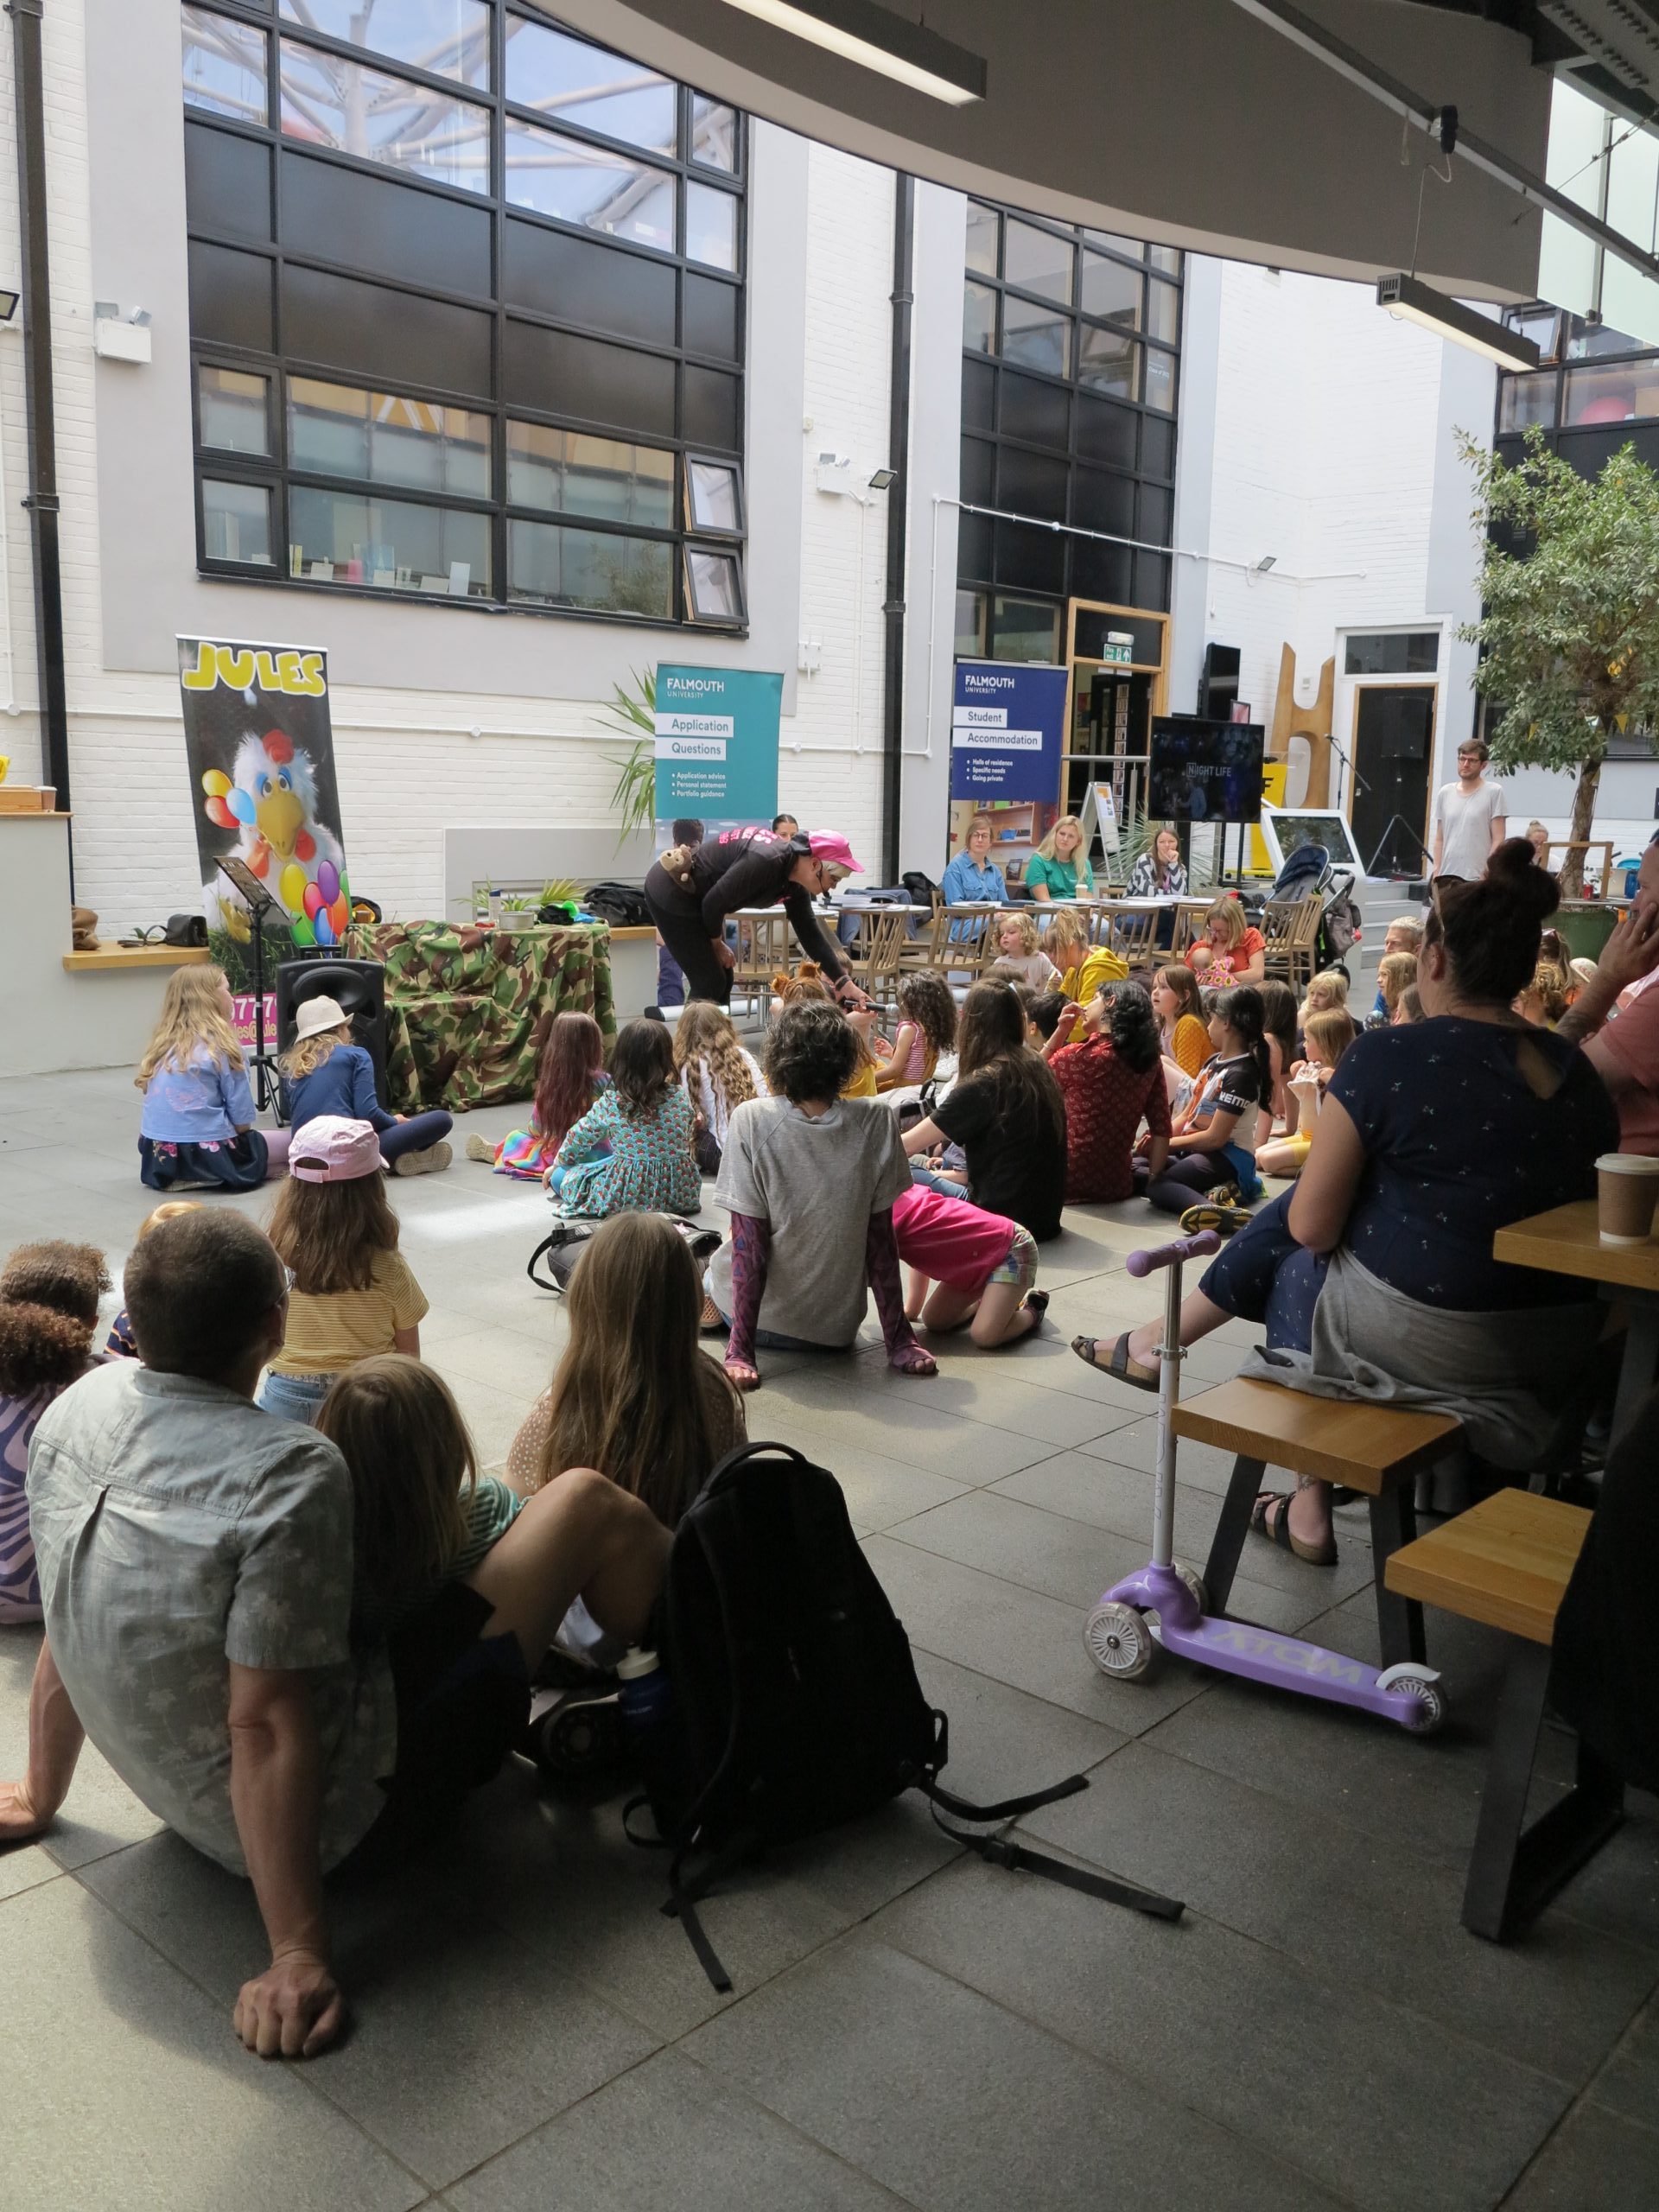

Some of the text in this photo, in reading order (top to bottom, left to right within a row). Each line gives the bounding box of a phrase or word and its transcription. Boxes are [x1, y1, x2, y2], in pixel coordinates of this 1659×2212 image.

[182, 642, 326, 697] JULES
[667, 677, 724, 692] FALMOUTH
[965, 675, 1014, 689] FALMOUTH
[968, 711, 1001, 722] Student
[671, 718, 728, 732] Application
[968, 733, 1038, 745] Accommodation
[671, 741, 721, 754] Questions
[1188, 764, 1231, 777] NIGHT LIFE
[1211, 1630, 1361, 1685] ATOM
